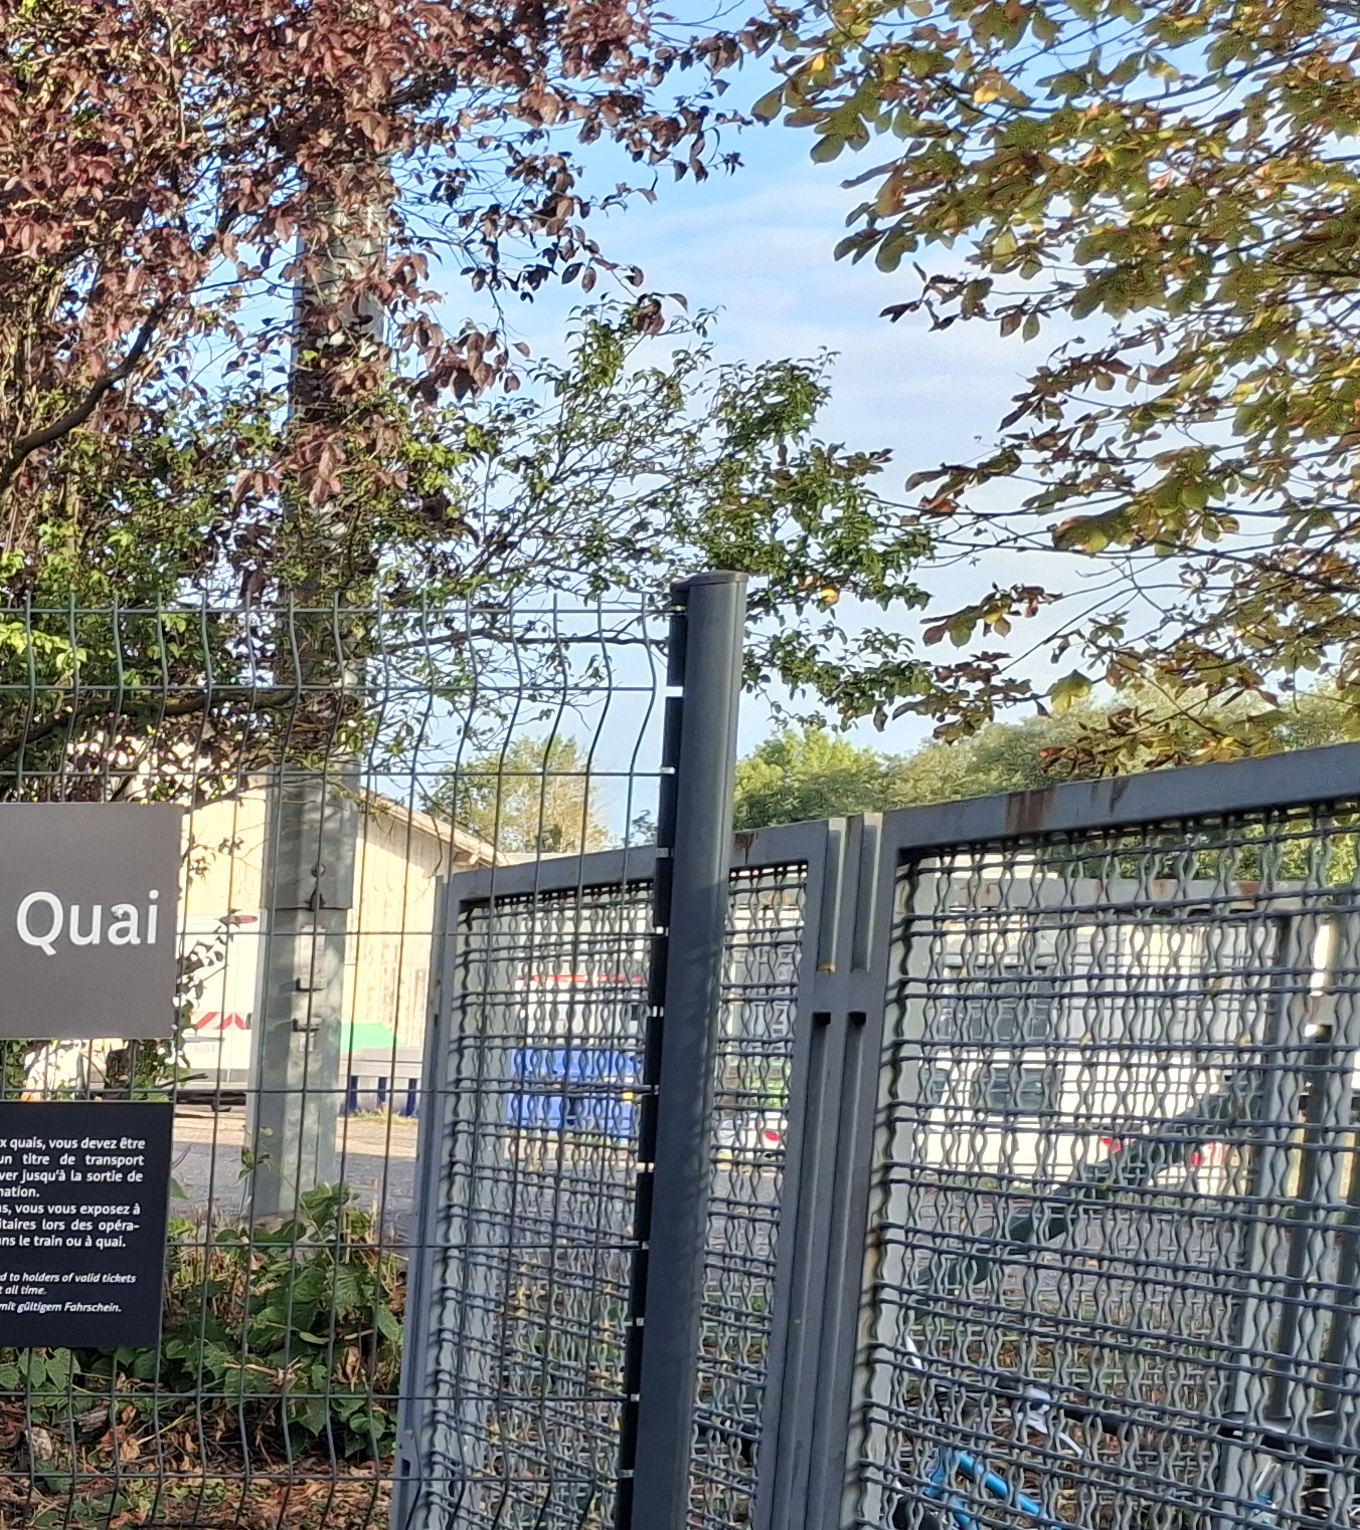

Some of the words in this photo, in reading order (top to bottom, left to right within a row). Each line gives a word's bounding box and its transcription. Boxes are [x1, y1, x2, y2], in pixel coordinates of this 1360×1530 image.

[16, 889, 159, 955] Quai
[9, 1136, 45, 1151] quais,
[48, 1139, 78, 1148] vous
[80, 1136, 117, 1149] devez
[119, 1136, 145, 1149] être
[22, 1152, 49, 1164] titre
[59, 1152, 75, 1165] de
[85, 1154, 144, 1168] transport
[19, 1168, 65, 1184] jusqu'à
[70, 1169, 81, 1181] la
[86, 1169, 123, 1181] sortie
[127, 1170, 143, 1182] de
[14, 1204, 44, 1213] vous
[47, 1204, 76, 1214] vous
[79, 1205, 130, 1217] exposez
[132, 1202, 140, 1214] à
[42, 1218, 65, 1230] lors
[70, 1218, 92, 1230] des
[98, 1218, 139, 1233] opéra-
[18, 1234, 30, 1246] le
[33, 1234, 62, 1246] train
[65, 1237, 81, 1246] ou
[84, 1234, 92, 1246] à
[95, 1235, 126, 1249] quai.
[4, 1284, 18, 1294] all
[64, 1301, 121, 1311] Fahrschein.
